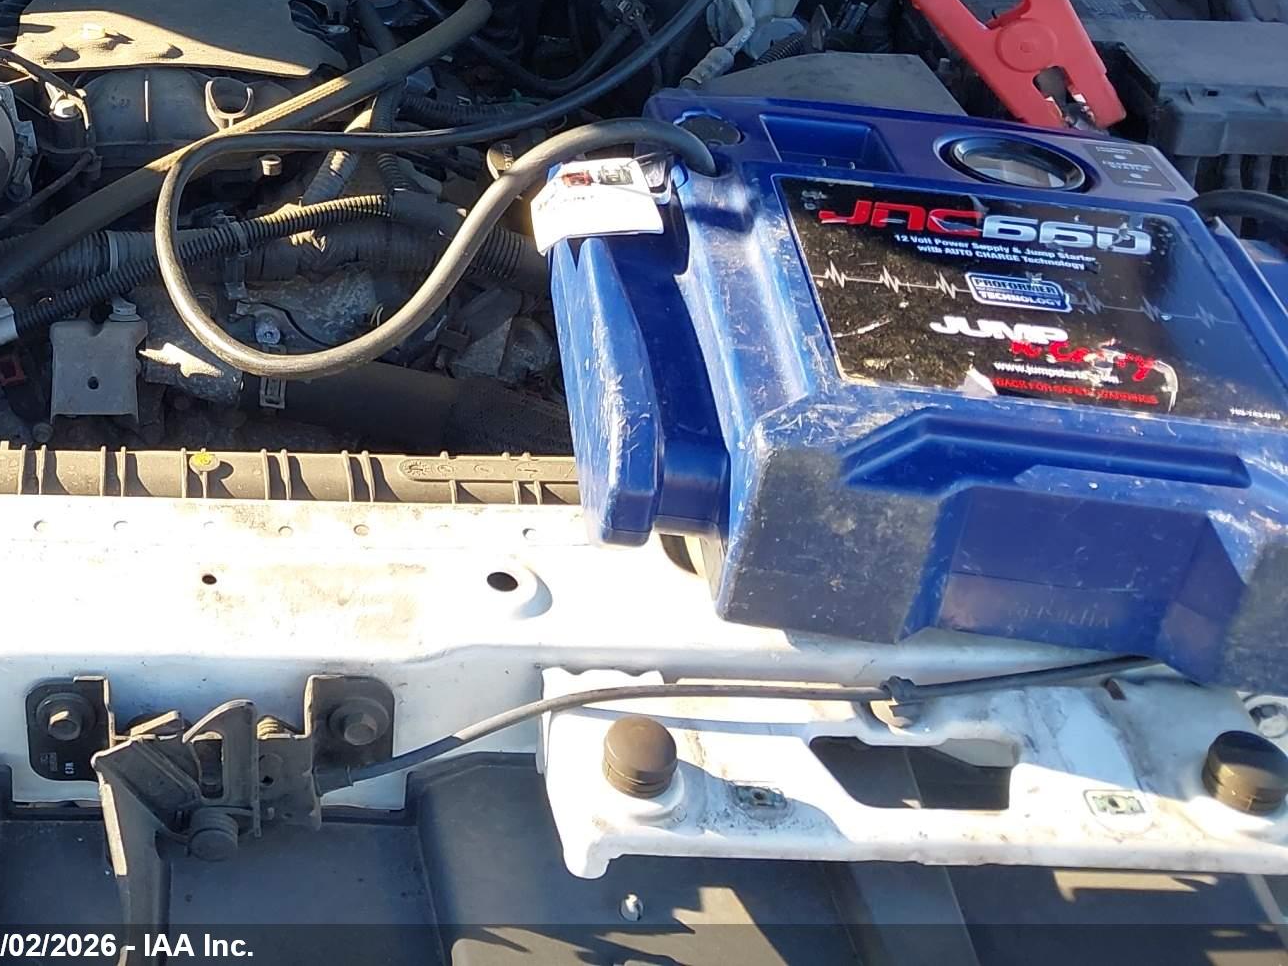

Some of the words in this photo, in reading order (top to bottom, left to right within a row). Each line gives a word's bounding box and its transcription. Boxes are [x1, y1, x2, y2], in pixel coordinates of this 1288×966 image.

[818, 200, 1152, 255] JNC660
[894, 234, 910, 243] 12
[912, 235, 933, 245] Volt
[935, 238, 968, 249] Power
[971, 241, 1010, 254] Supply
[1024, 246, 1056, 260] Jump
[1057, 251, 1096, 263] Starter
[917, 245, 942, 254] with
[944, 247, 973, 258] AUTO
[975, 249, 1020, 263] CHARGE
[1021, 255, 1085, 271] Technology
[979, 290, 1062, 307] TECHNOLOGY
[929, 315, 1068, 344] JUMP
